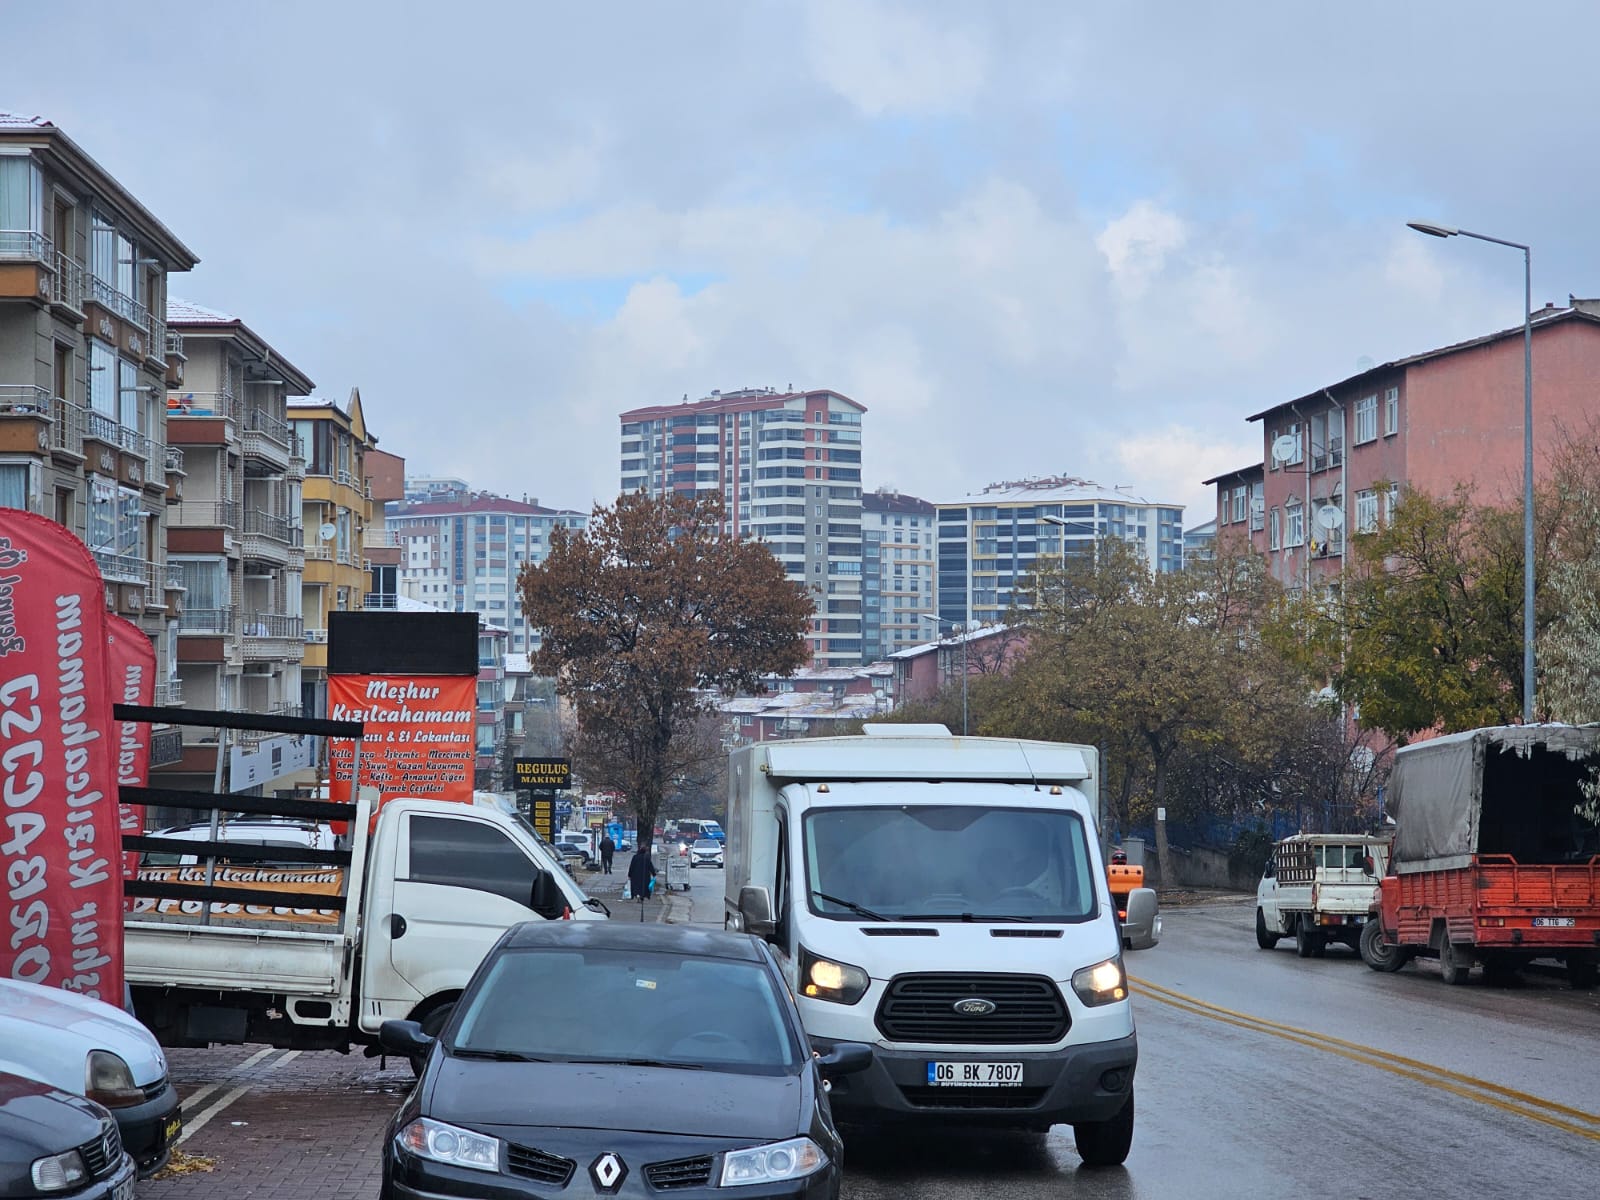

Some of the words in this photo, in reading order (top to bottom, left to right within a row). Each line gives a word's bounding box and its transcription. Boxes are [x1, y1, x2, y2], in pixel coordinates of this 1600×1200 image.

[366, 681, 440, 704] Meşhur
[332, 703, 471, 722] Kızılcahamam
[386, 730, 395, 742] &
[398, 730, 410, 742] Et
[413, 730, 470, 743] Lokantası
[359, 752, 375, 761] aça
[396, 761, 423, 771] Kazan
[425, 761, 464, 770] Kavurma
[516, 763, 568, 775] REGULUS
[402, 773, 437, 781] Arnavut
[378, 783, 406, 794] Yemek
[937, 1065, 954, 1080] 06
[964, 1065, 980, 1080] BK
[988, 1065, 1021, 1080] 7807
